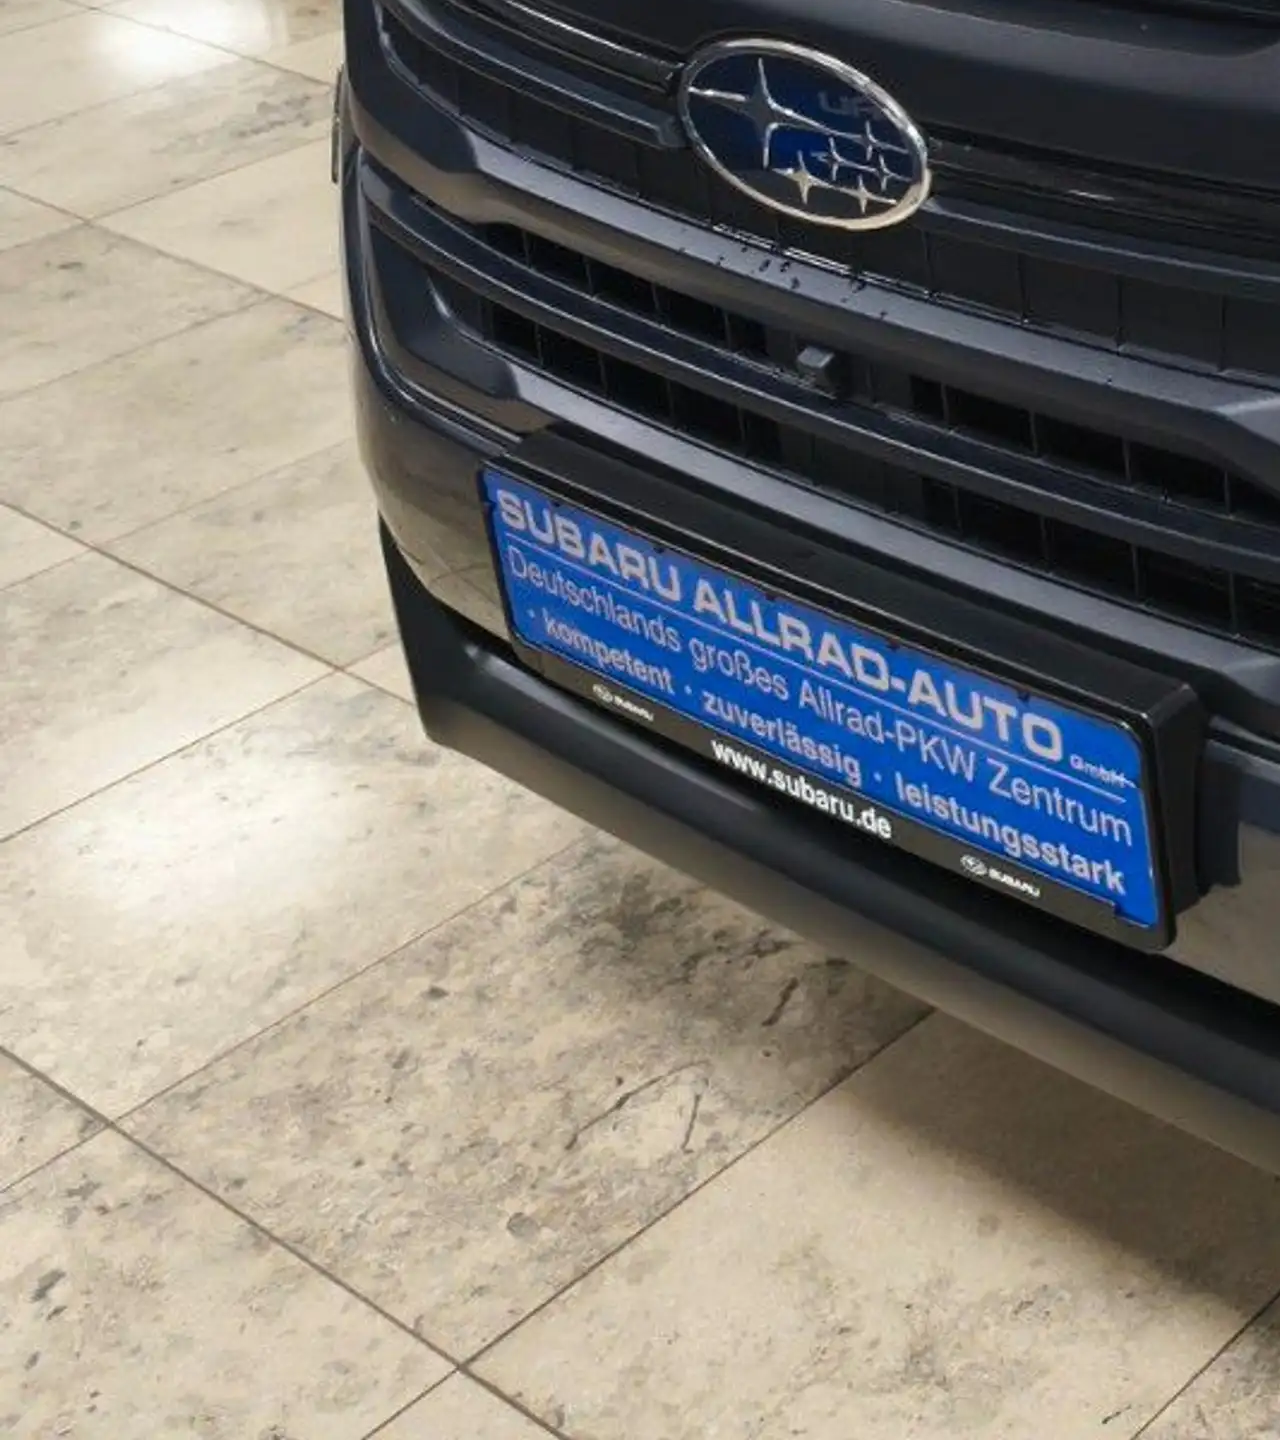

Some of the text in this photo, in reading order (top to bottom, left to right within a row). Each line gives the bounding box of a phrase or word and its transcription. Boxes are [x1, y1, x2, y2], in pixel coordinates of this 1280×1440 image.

[497, 488, 681, 602] SUBARU
[693, 578, 1063, 761] ALLRAD-AUTO
[507, 545, 1132, 847] Deutschlands großes Allrad-PKW Zentrum
[543, 606, 1127, 896] kompetent zuverlässig leistungsstark
[711, 739, 892, 840] www.subaru.de
[988, 867, 1041, 898] SUBARU
